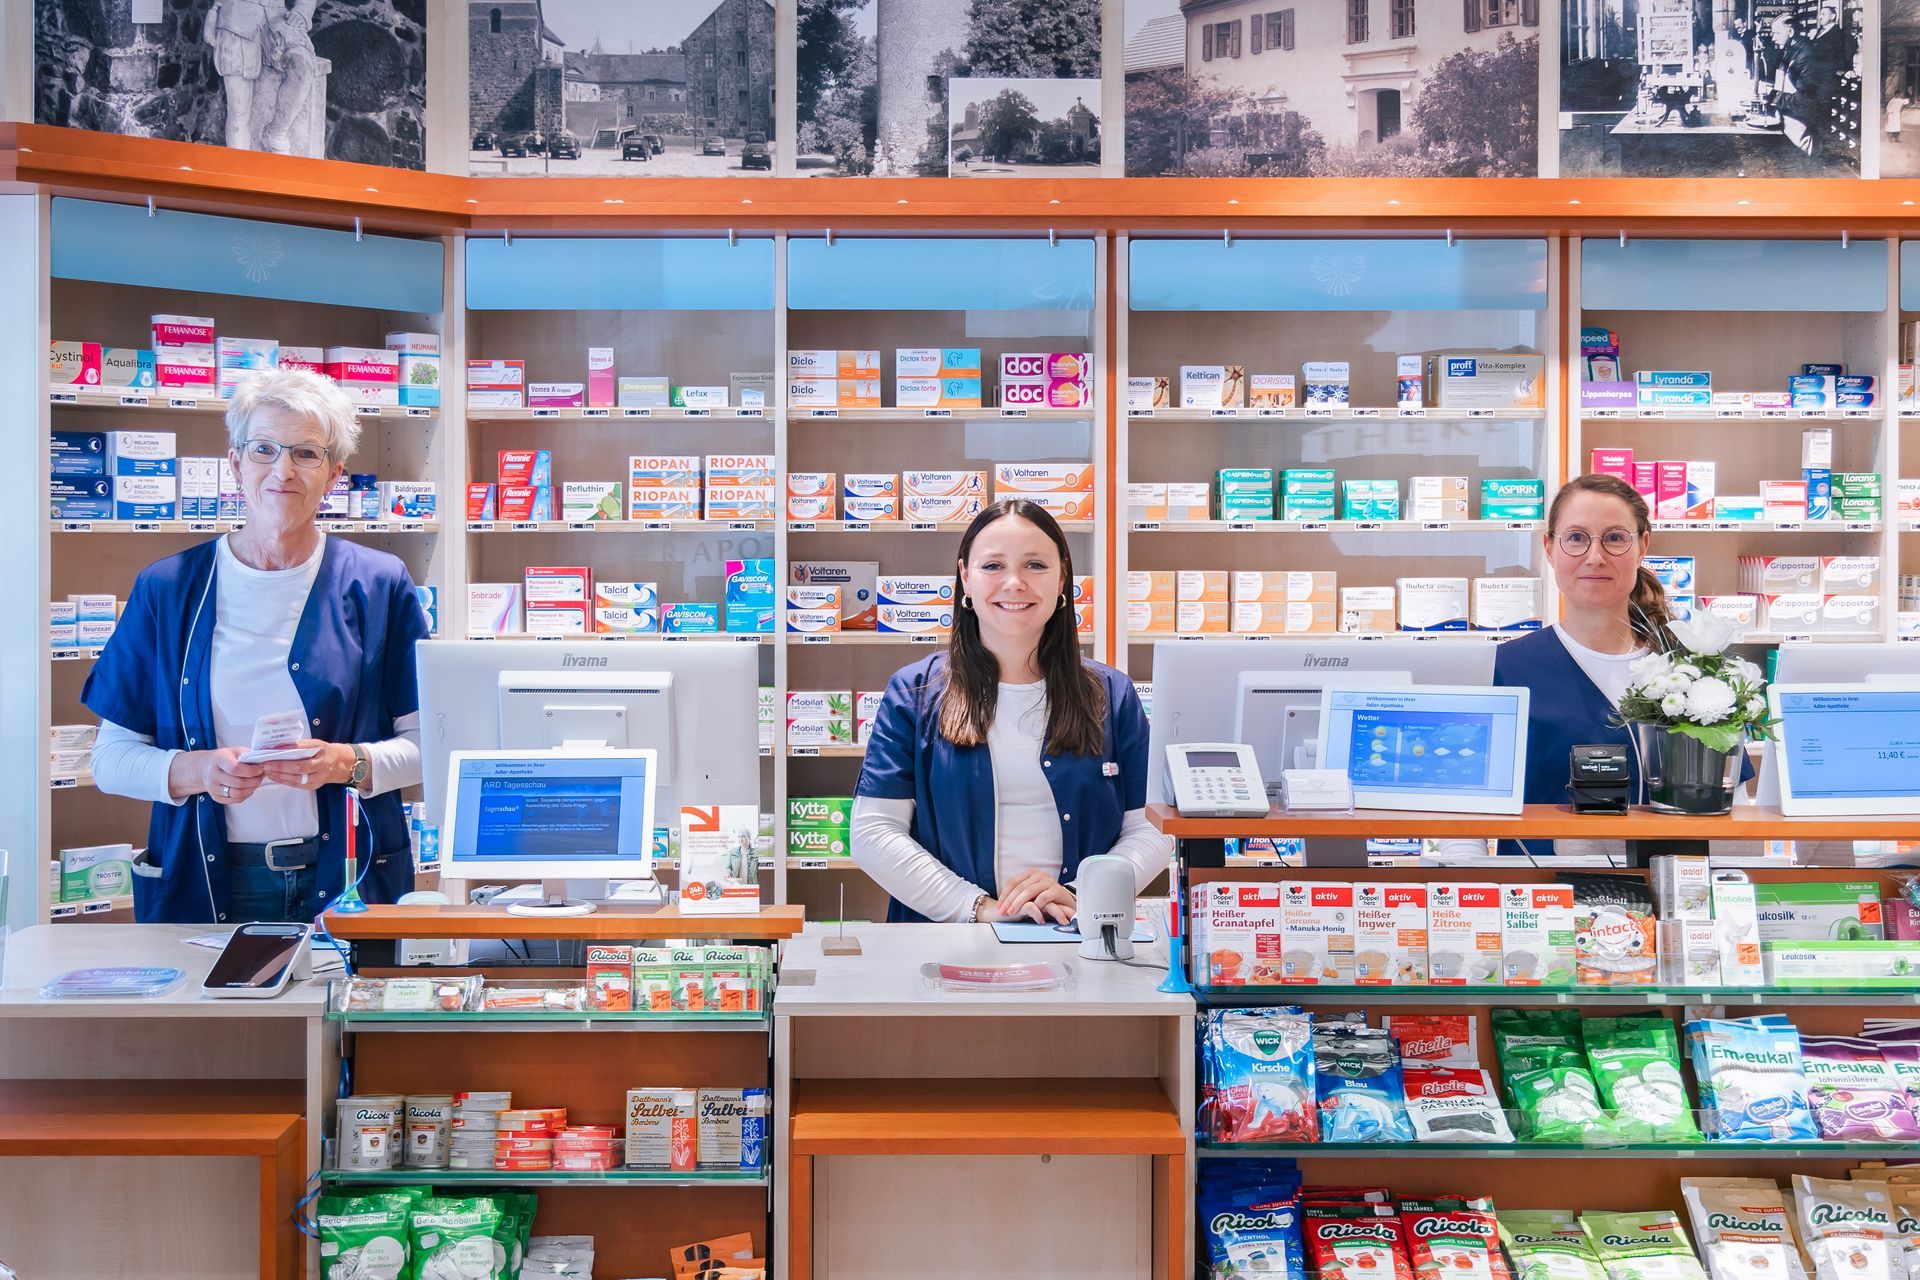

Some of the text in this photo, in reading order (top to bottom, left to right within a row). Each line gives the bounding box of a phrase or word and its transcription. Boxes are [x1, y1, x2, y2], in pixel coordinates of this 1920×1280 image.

[164, 326, 206, 336] FEMANNOSE
[50, 350, 94, 363] Cystinol
[900, 355, 919, 363] Diclox
[106, 358, 152, 369] Aqualibra
[1006, 359, 1042, 374] doc
[1451, 360, 1472, 371] proff
[1478, 362, 1526, 370] Vita-Komplex
[164, 367, 207, 377] FEMANNOSE
[348, 364, 392, 375] FEMANNOSE
[1810, 365, 1830, 374] Zovirax
[1186, 371, 1220, 380] Keltican
[1655, 375, 1693, 385] Lyranda
[1794, 377, 1816, 385] Zovirax
[1838, 377, 1861, 385] Zovirax
[900, 384, 919, 392] Diclox
[1007, 387, 1042, 402] doc
[1582, 390, 1632, 400] Lippenherpes
[1655, 394, 1694, 404] Lyranda
[506, 454, 531, 463] Rennie
[710, 458, 766, 468] RIOPAN
[633, 460, 690, 470] RIOPAN
[920, 473, 952, 481] Voltaren
[1014, 468, 1048, 478] Voltaren
[395, 485, 432, 494] Baldriparan
[1497, 484, 1538, 494] ASPIRIN
[633, 491, 690, 501] RIOPAN
[710, 490, 766, 500] RIOPAN
[920, 496, 952, 505] Voltaren
[1643, 561, 1691, 570] BoxaGrippal
[1770, 562, 1815, 570] Grippostad
[1830, 562, 1875, 570] Grippostad
[809, 566, 847, 576] Voltaren
[732, 575, 768, 583] GAVISCON
[603, 585, 628, 595] Talcid
[895, 581, 930, 591] Voltaren
[83, 600, 112, 608] Neurexan
[603, 610, 628, 620] Talcid
[666, 610, 707, 618] GAVISCON
[895, 609, 931, 619] Voltaren
[82, 625, 112, 634] Neurexan
[563, 653, 608, 667] iiyama
[1304, 653, 1349, 667] iiyama
[791, 698, 824, 706] Mobilat
[1878, 751, 1898, 760] 11,40
[504, 781, 546, 790] Tagesschau
[791, 802, 829, 818] Kytta
[791, 831, 829, 847] Kytta
[70, 853, 96, 866] Artelac
[96, 870, 122, 880] TRÖSTER
[1680, 868, 1703, 876] ipalat
[1586, 895, 1627, 905] Fußball
[1212, 910, 1246, 918] Heißer
[1358, 910, 1392, 919] Heißer
[1432, 910, 1461, 918] Heiße
[1506, 911, 1539, 920] Heißer
[1212, 918, 1275, 929] Granatapfel
[1358, 920, 1396, 930] Ingwer
[1432, 920, 1472, 928] Zitrone
[1507, 920, 1538, 929] Salbei
[1592, 922, 1638, 937] intact
[1689, 932, 1712, 940] ipalat
[590, 950, 628, 960] Ricola
[706, 951, 743, 960] Ricola
[1406, 1036, 1451, 1056] Rheila
[1252, 1064, 1290, 1073] Kirsche
[1345, 1080, 1367, 1088] Blau
[1422, 1081, 1466, 1096] Rheila
[409, 1107, 441, 1118] Ricola
[631, 1103, 684, 1117] Salbei-
[701, 1102, 754, 1116] Salbei-
[1811, 1204, 1888, 1224] Ricola
[1416, 1218, 1491, 1235] Ricola
[1709, 1214, 1783, 1231] Ricola
[1320, 1226, 1396, 1239] Ricola
[1514, 1234, 1582, 1245] Ricola
[1604, 1235, 1671, 1245] Ricola
